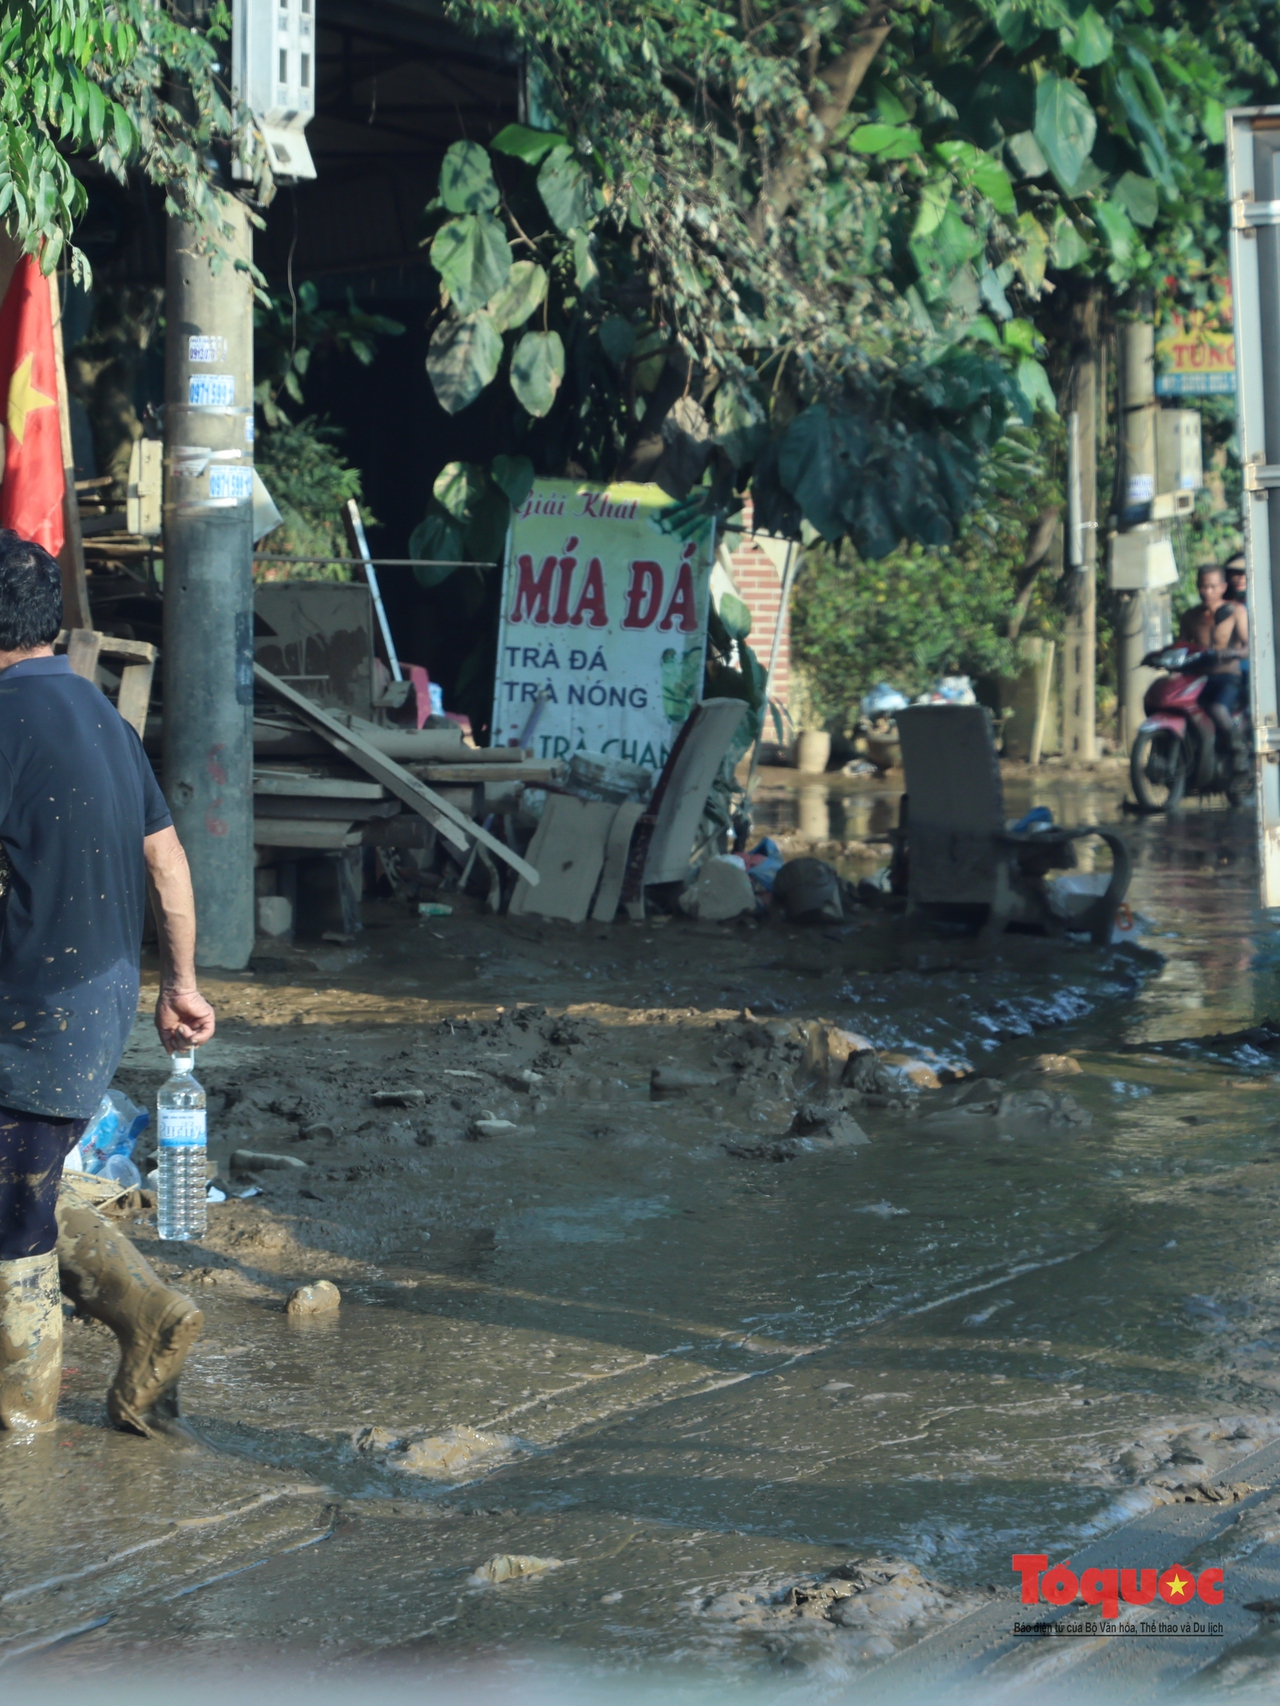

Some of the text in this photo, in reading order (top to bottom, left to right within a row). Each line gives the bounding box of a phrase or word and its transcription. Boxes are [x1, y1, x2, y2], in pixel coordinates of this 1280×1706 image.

[509, 535, 699, 632] MÍA ĐÁ
[506, 643, 608, 672] TRÀ ĐÁ
[503, 677, 649, 709] TRÀ NÓNG
